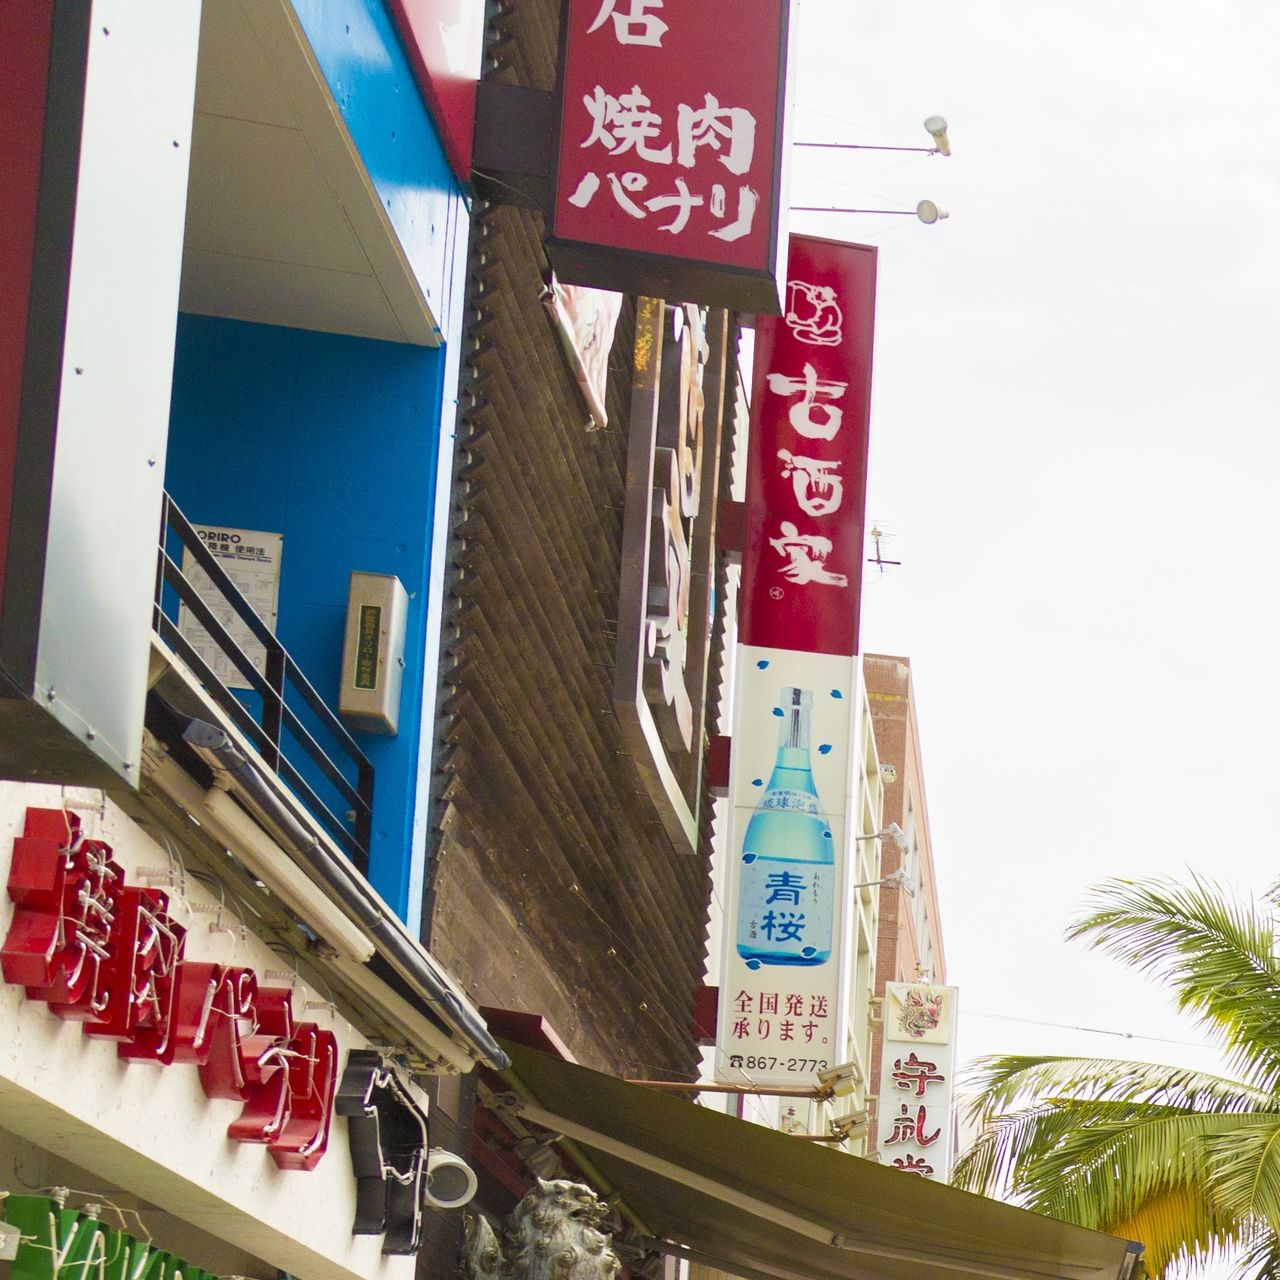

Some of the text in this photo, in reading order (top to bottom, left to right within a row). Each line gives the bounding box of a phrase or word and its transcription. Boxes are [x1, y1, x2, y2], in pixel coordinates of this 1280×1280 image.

[580, 84, 758, 175] 焼肉
[567, 171, 760, 241] パナリ
[732, 990, 830, 1021] 全国発送
[731, 1017, 830, 1046] 承ります。
[745, 1054, 829, 1074] 867-2773
